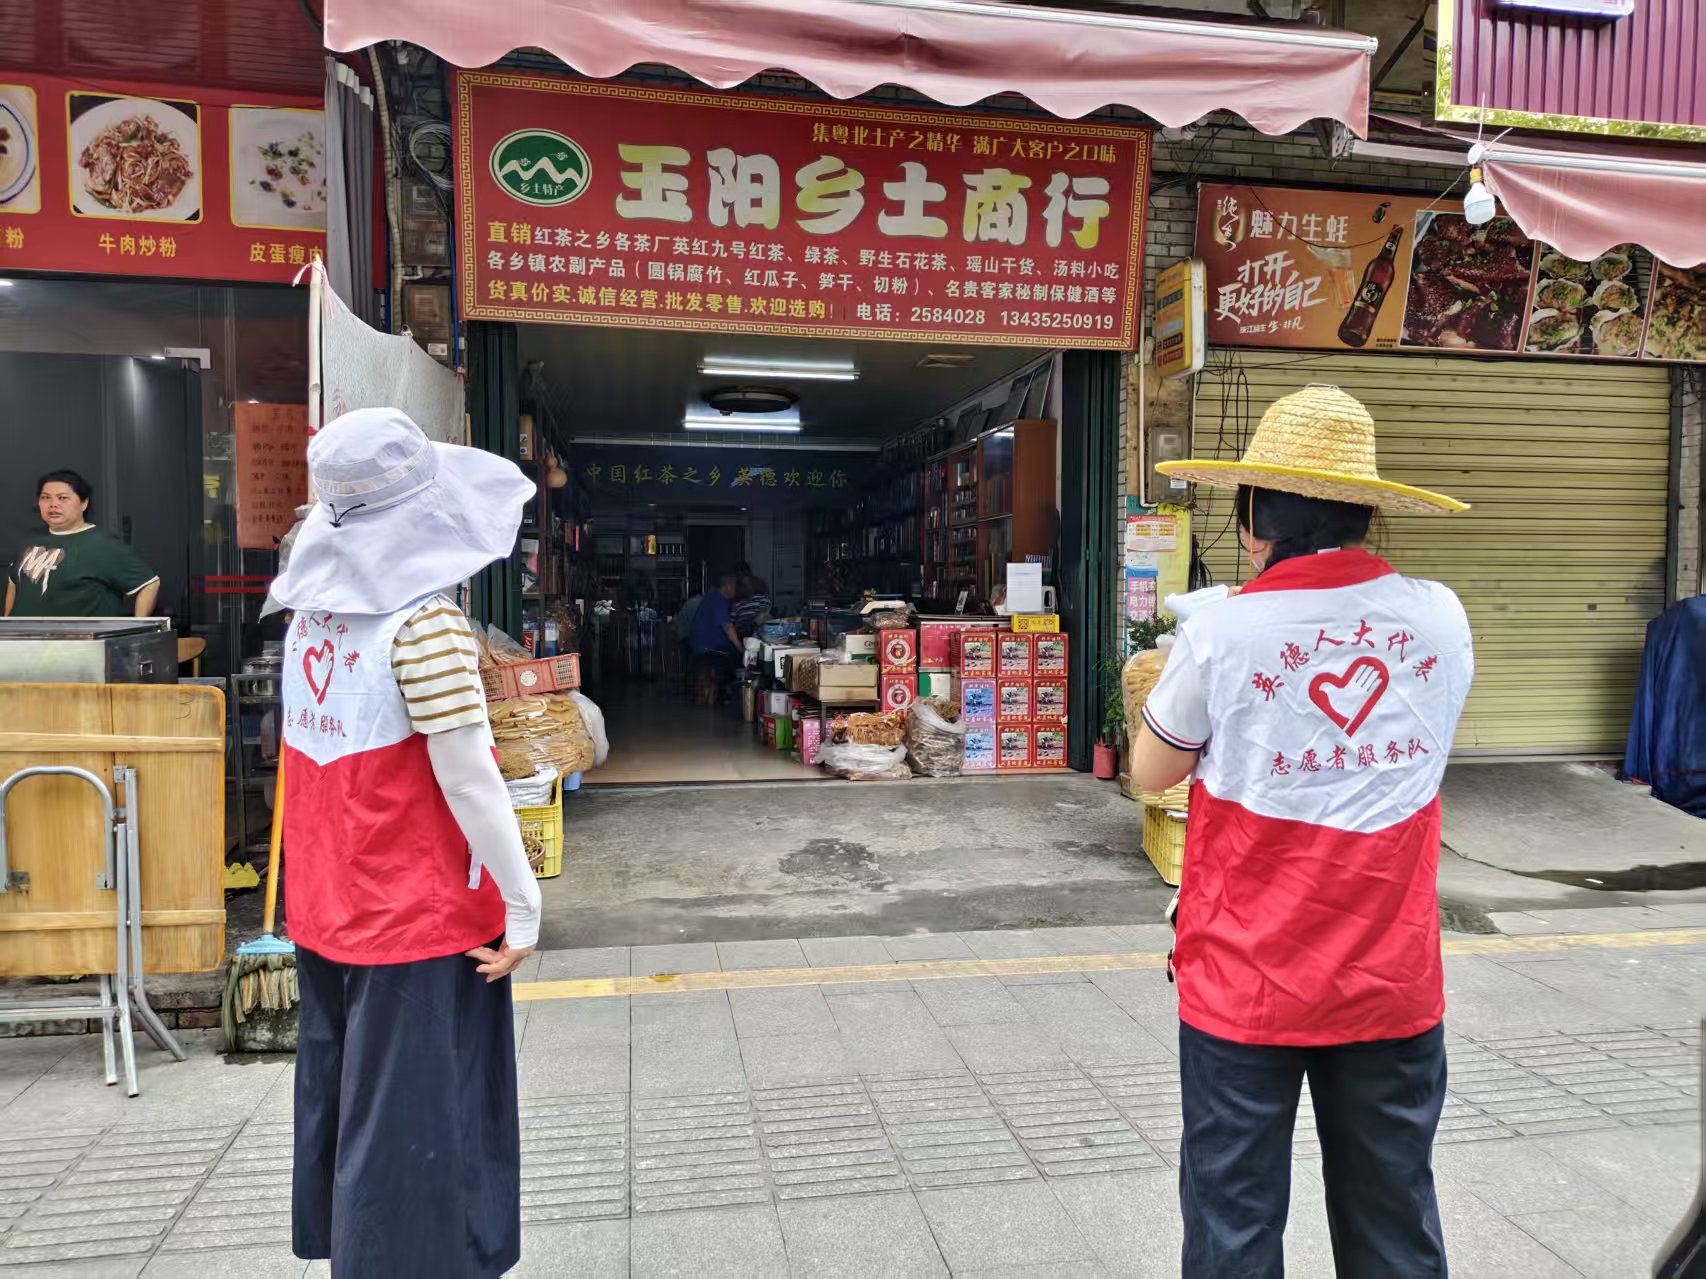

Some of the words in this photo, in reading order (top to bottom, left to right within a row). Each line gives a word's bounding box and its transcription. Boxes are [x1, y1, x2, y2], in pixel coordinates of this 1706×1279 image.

[811, 122, 963, 151] 集粤北土产之精华
[972, 135, 1117, 163] 满广大客户之口味
[519, 182, 566, 197] 乡土特产
[615, 142, 1110, 249] 玉阳乡土商行
[0, 226, 25, 249] 粉
[1250, 209, 1349, 243] 魅力生蚝
[98, 232, 177, 258] 牛肉炒粉
[1236, 250, 1297, 283] 打开
[1214, 270, 1329, 324] 更好的自己
[1000, 309, 1114, 330] 13435250919
[585, 463, 722, 487] 中国红茶之乡
[1251, 618, 1438, 702] 英德人大代表
[1270, 737, 1430, 777] 志愿者服务队
